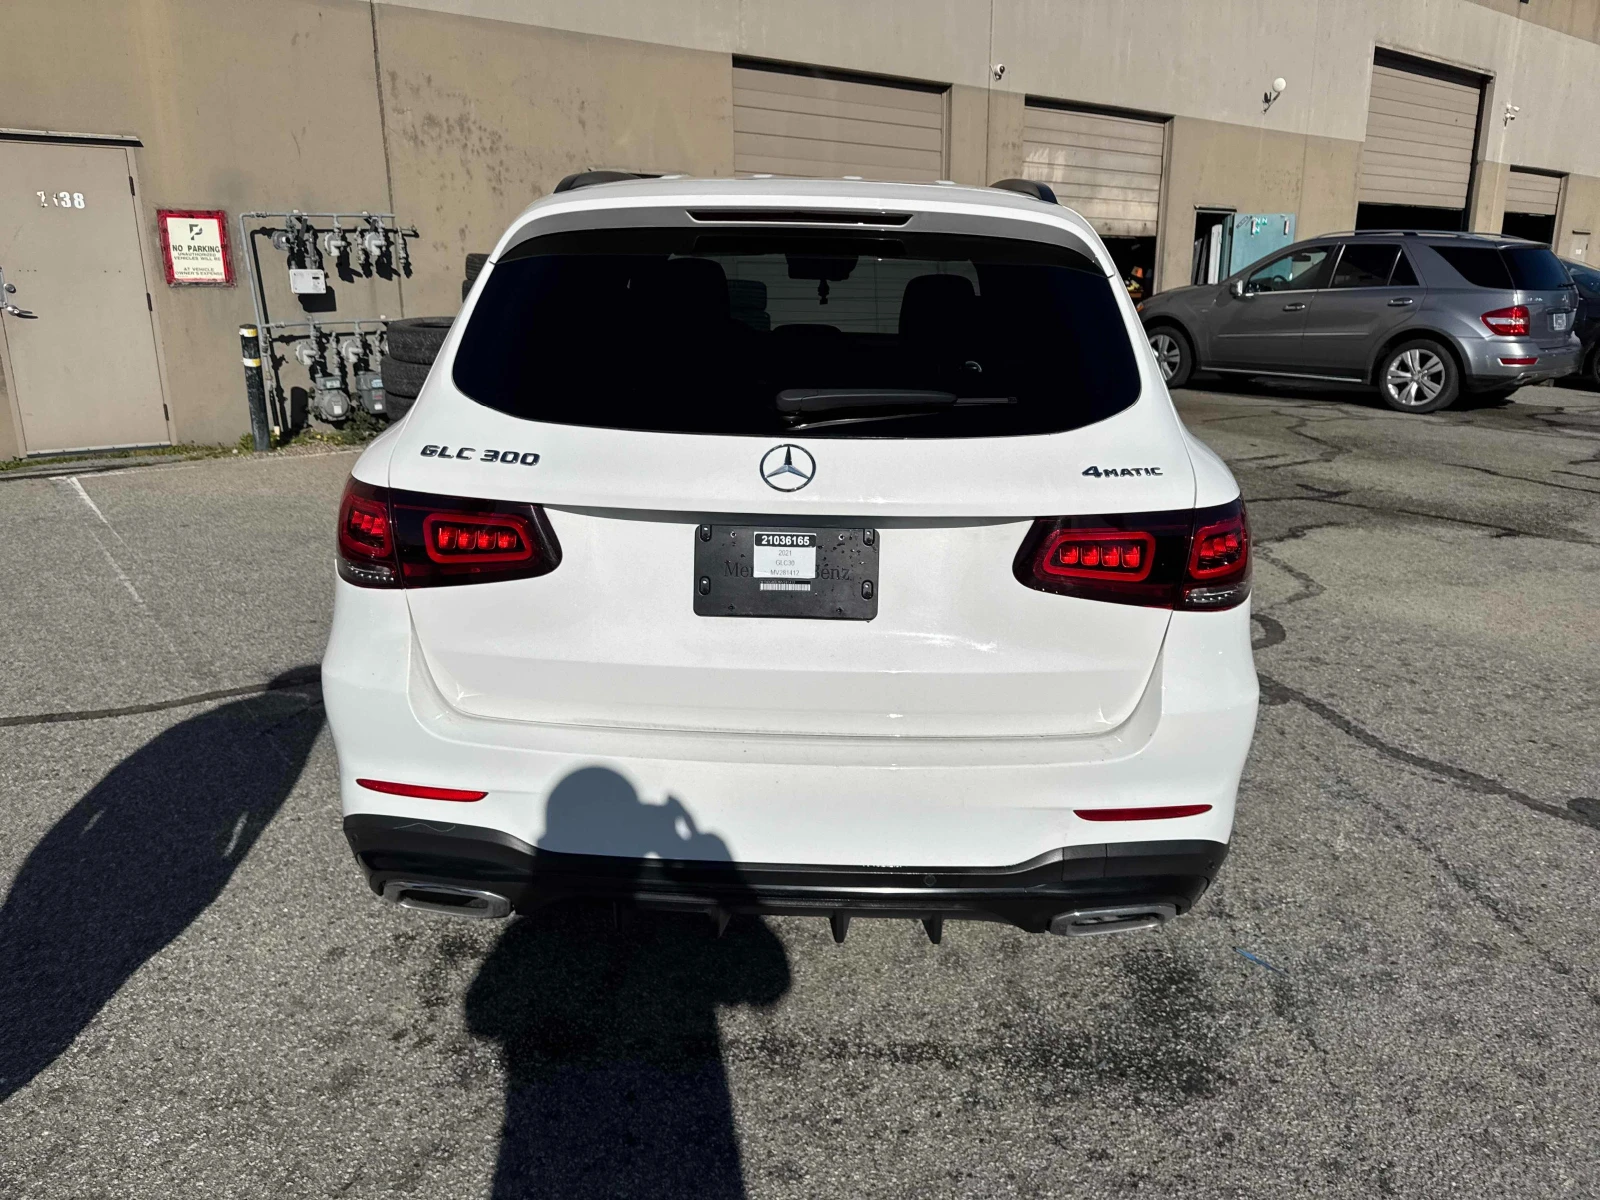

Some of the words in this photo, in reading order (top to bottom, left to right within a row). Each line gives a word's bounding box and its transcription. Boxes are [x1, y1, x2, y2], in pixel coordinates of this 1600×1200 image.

[172, 244, 183, 252] NO
[187, 244, 220, 253] PARKING
[420, 444, 476, 461] GLC
[479, 449, 541, 467] 300
[1081, 465, 1164, 479] 4MATIC
[761, 535, 810, 546] 21036165
